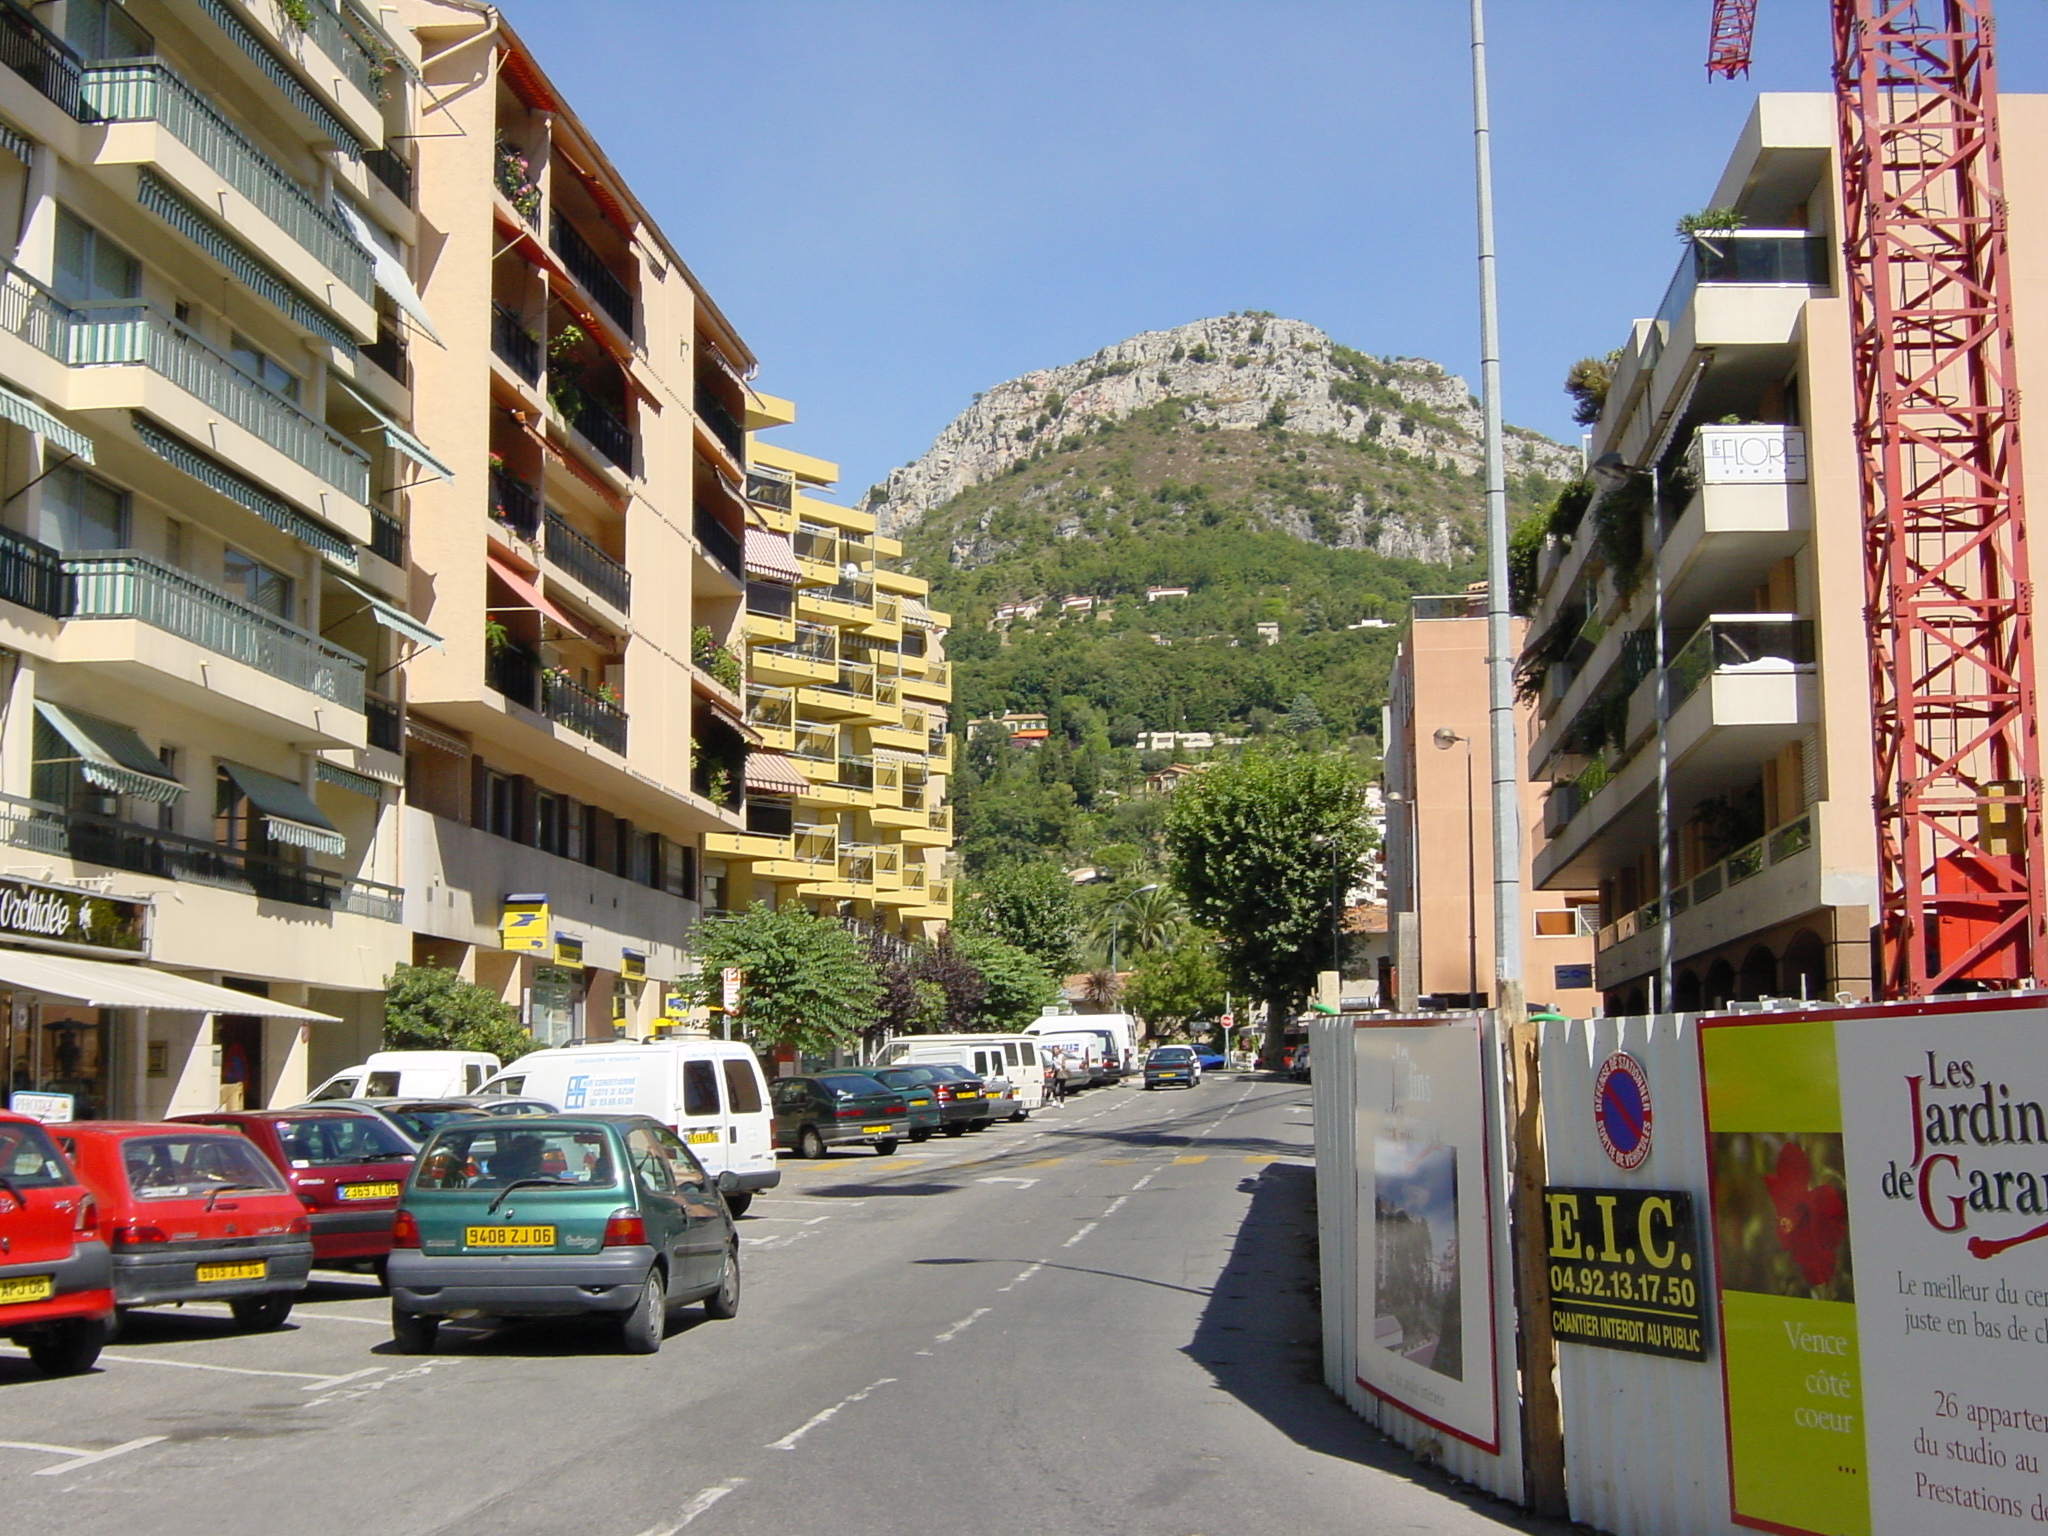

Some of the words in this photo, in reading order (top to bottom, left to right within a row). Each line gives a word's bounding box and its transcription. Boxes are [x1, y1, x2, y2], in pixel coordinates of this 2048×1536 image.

[1722, 437, 1797, 466] FLORE
[1925, 1051, 1975, 1089] Les
[1882, 1161, 1914, 1200] de
[470, 1229, 506, 1244] 9408
[511, 1229, 529, 1243] ZJ
[533, 1228, 551, 1243] 06
[1545, 1194, 1692, 1270] E.I.C.
[1551, 1265, 1695, 1308] 04.92.13.17.50
[1897, 1270, 1917, 1295] Le
[1923, 1274, 1989, 1302] meilleur
[1996, 1278, 2018, 1304] du
[1552, 1310, 1599, 1337] CHANTIER
[1600, 1317, 1645, 1343] INTERDIT
[1647, 1323, 1661, 1346] AU
[1662, 1325, 1700, 1352] PUBLIC
[1783, 1321, 1848, 1356] Vence
[1905, 1307, 1941, 1335] juste
[1947, 1318, 1967, 1335] en
[1973, 1310, 2002, 1339] bas
[2007, 1315, 2028, 1341] de
[1806, 1369, 1851, 1398] côté
[1795, 1407, 1853, 1433] coeur
[1934, 1390, 1959, 1418] 26
[1914, 1426, 1939, 1456] du
[1946, 1437, 2007, 1468] studio
[2015, 1453, 2039, 1473] au
[1915, 1471, 2023, 1518] Prestations
